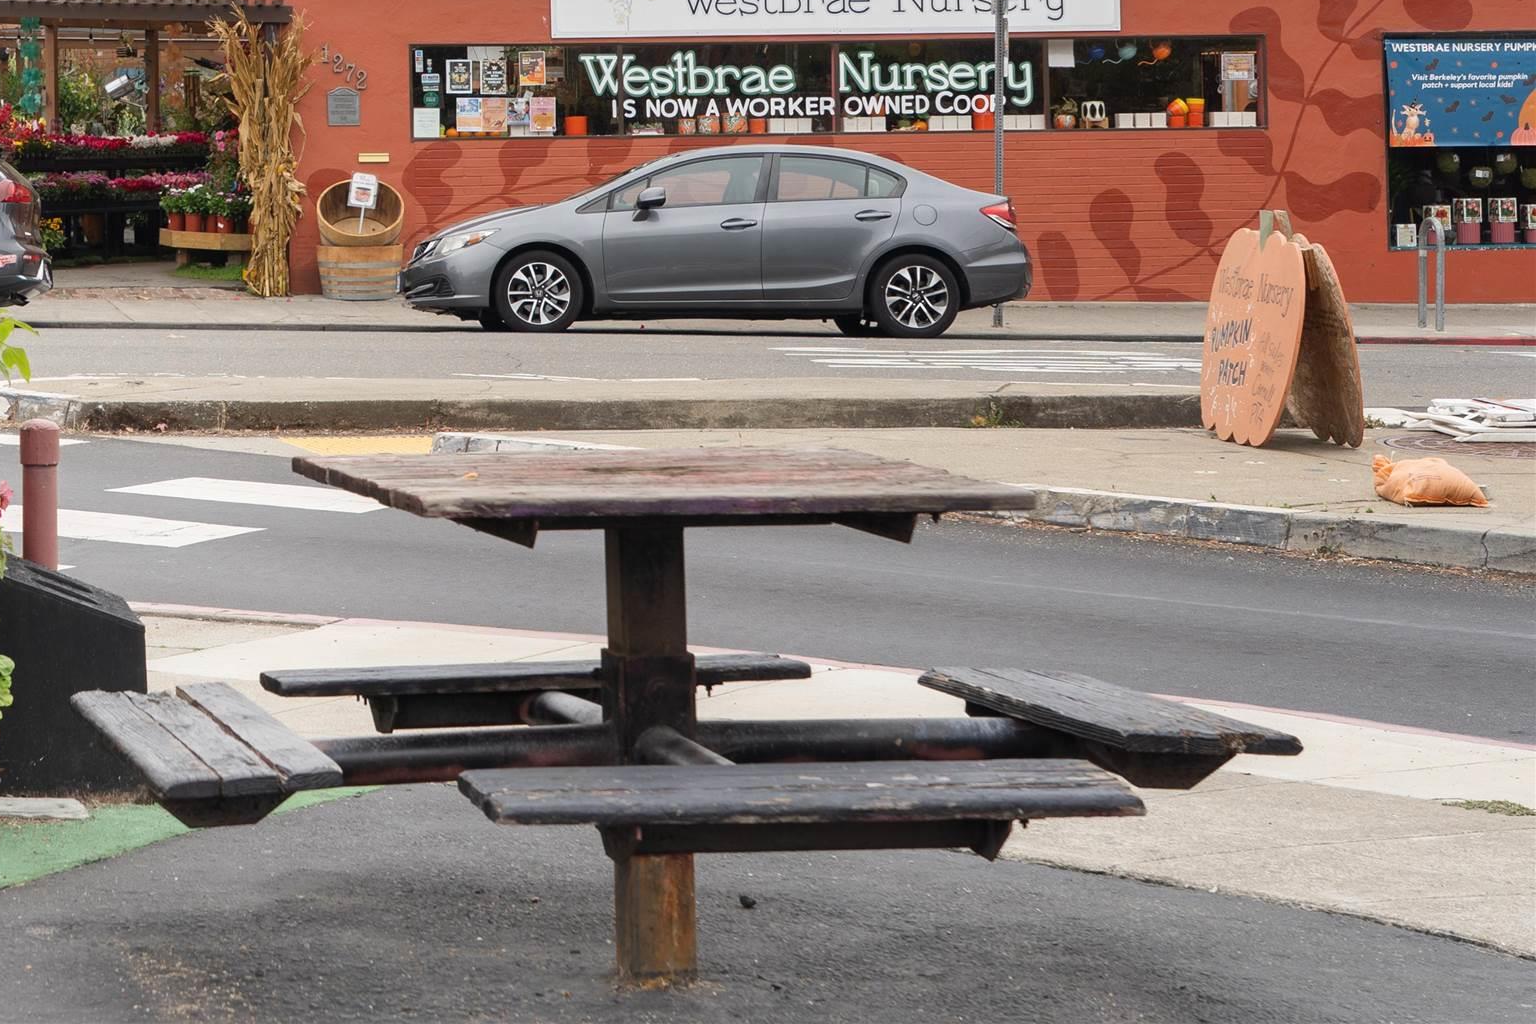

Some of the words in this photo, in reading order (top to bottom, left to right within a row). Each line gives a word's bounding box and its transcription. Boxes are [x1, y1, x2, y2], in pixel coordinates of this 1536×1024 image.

[1391, 42, 1451, 53] WESTBRAE
[1452, 42, 1501, 52] NURSERY
[578, 49, 796, 98] Westbrae
[838, 50, 1033, 106] Nursery
[1411, 73, 1428, 81] Visit
[1429, 73, 1467, 82] Berkeley's
[1468, 73, 1497, 81] favorite
[1498, 73, 1528, 83] pumpkin
[1421, 81, 1443, 90] patch
[1450, 82, 1478, 90] support
[612, 99, 637, 118] IS
[646, 98, 698, 118] NOW
[705, 97, 721, 117] A
[726, 97, 836, 118] WORKER
[844, 95, 930, 116] OWNED
[1210, 318, 1253, 353] PUMPKIN
[1218, 358, 1248, 386] PATCH
